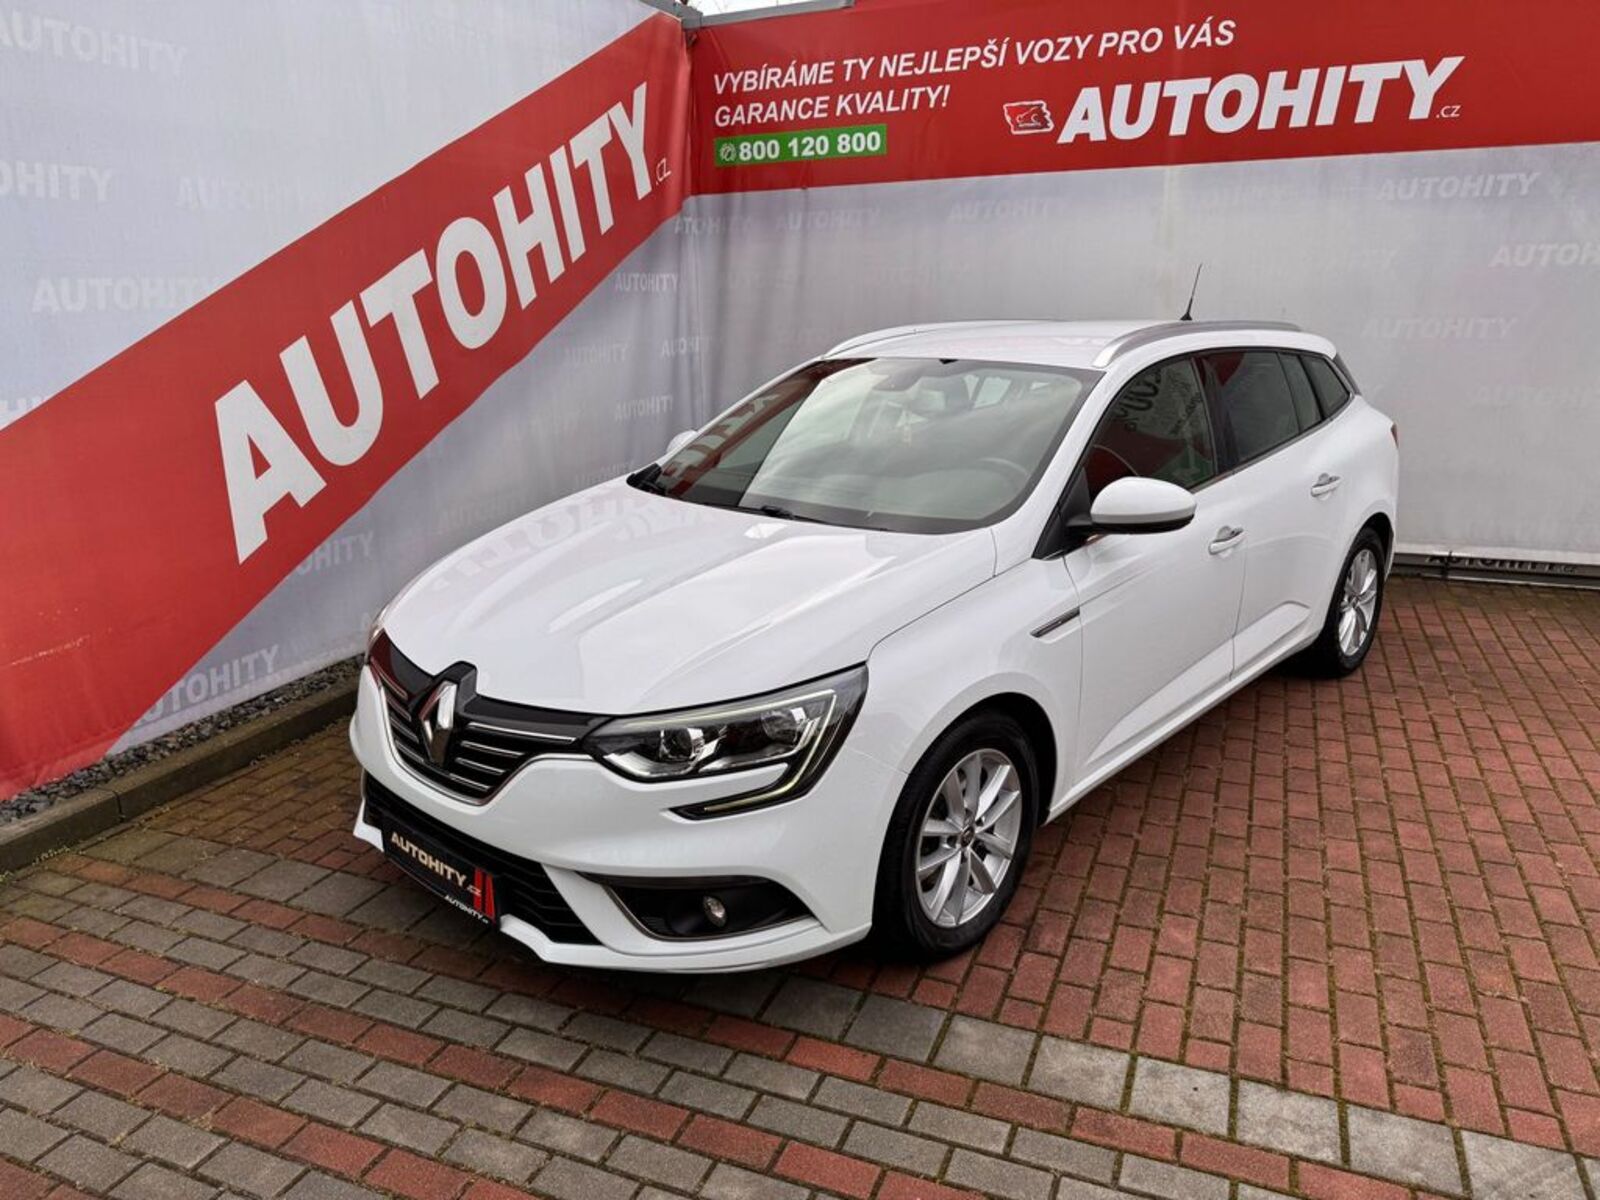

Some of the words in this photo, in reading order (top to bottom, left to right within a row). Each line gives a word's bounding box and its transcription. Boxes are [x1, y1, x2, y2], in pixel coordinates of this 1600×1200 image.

[713, 60, 835, 95] VYBÍRÁME
[842, 57, 875, 81] TY
[879, 37, 1011, 78] NEJLEPŠÍ
[1015, 33, 1094, 65] VOZY
[1098, 27, 1164, 57] PRO
[1173, 16, 1236, 49] VÁS
[714, 96, 830, 128] GARANCE
[835, 85, 950, 117] KVALITY!
[738, 138, 781, 162] 800
[787, 135, 830, 159] 120
[836, 131, 881, 155] 800
[1374, 171, 1542, 200] AUTOHITY
[614, 271, 678, 293] AUTOHITY
